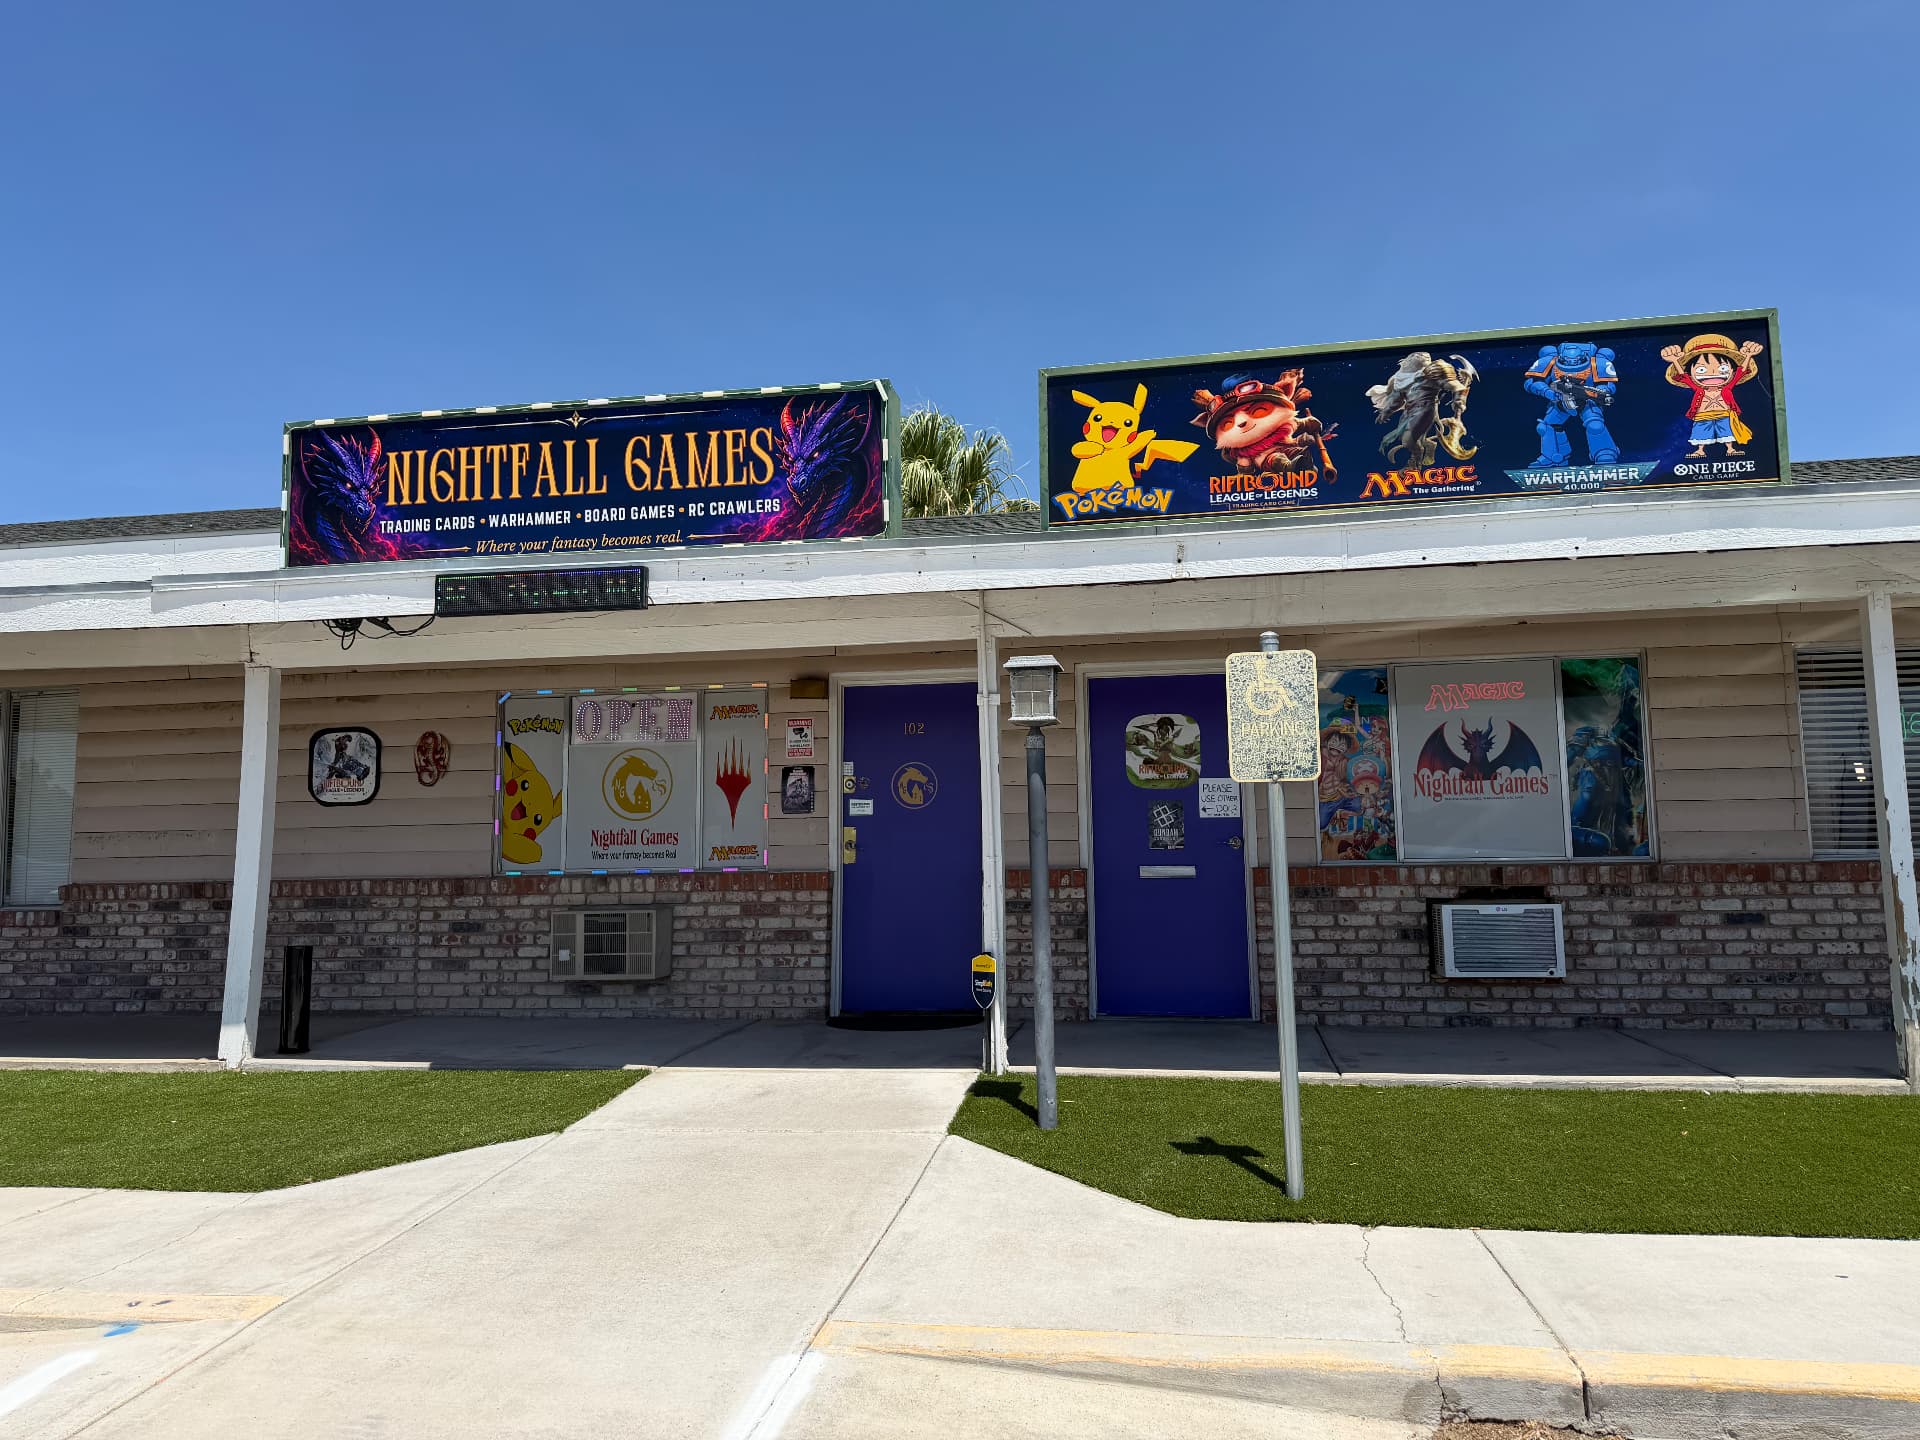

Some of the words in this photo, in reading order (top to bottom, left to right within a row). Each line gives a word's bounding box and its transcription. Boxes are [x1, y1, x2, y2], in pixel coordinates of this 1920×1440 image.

[385, 438, 608, 506] NIGHTFALL
[624, 427, 775, 492] GAMES
[1674, 463, 1710, 476] ONE
[1712, 460, 1756, 474] PIECE
[1209, 470, 1318, 494] RIFTBOUND
[1524, 467, 1640, 486] WARHAMMER
[1209, 492, 1255, 504] LEAGUE
[1264, 487, 1319, 500] LEGENDS
[1413, 486, 1430, 494] The
[1431, 485, 1475, 493] Gathering
[380, 518, 431, 534] TRADING
[435, 515, 475, 531] CARDS
[488, 510, 571, 528] WARHAMMER
[584, 507, 626, 523] BOARD
[630, 504, 675, 520] GAMES
[688, 502, 705, 517] RC
[709, 498, 781, 516] CRAWLERS
[476, 540, 515, 553] Where
[518, 540, 549, 555] your
[549, 536, 598, 553] fantasy
[601, 534, 652, 547] becomes
[655, 529, 683, 544] real.
[576, 699, 692, 741] OPEN
[904, 722, 925, 735] 102
[1241, 721, 1306, 737] PARKING
[1202, 783, 1233, 793] PLEASE
[1414, 772, 1485, 802] Nightfall
[1490, 771, 1550, 795] Games
[1200, 794, 1216, 803] USE
[591, 828, 637, 851] Nightfall
[640, 828, 679, 847] Games
